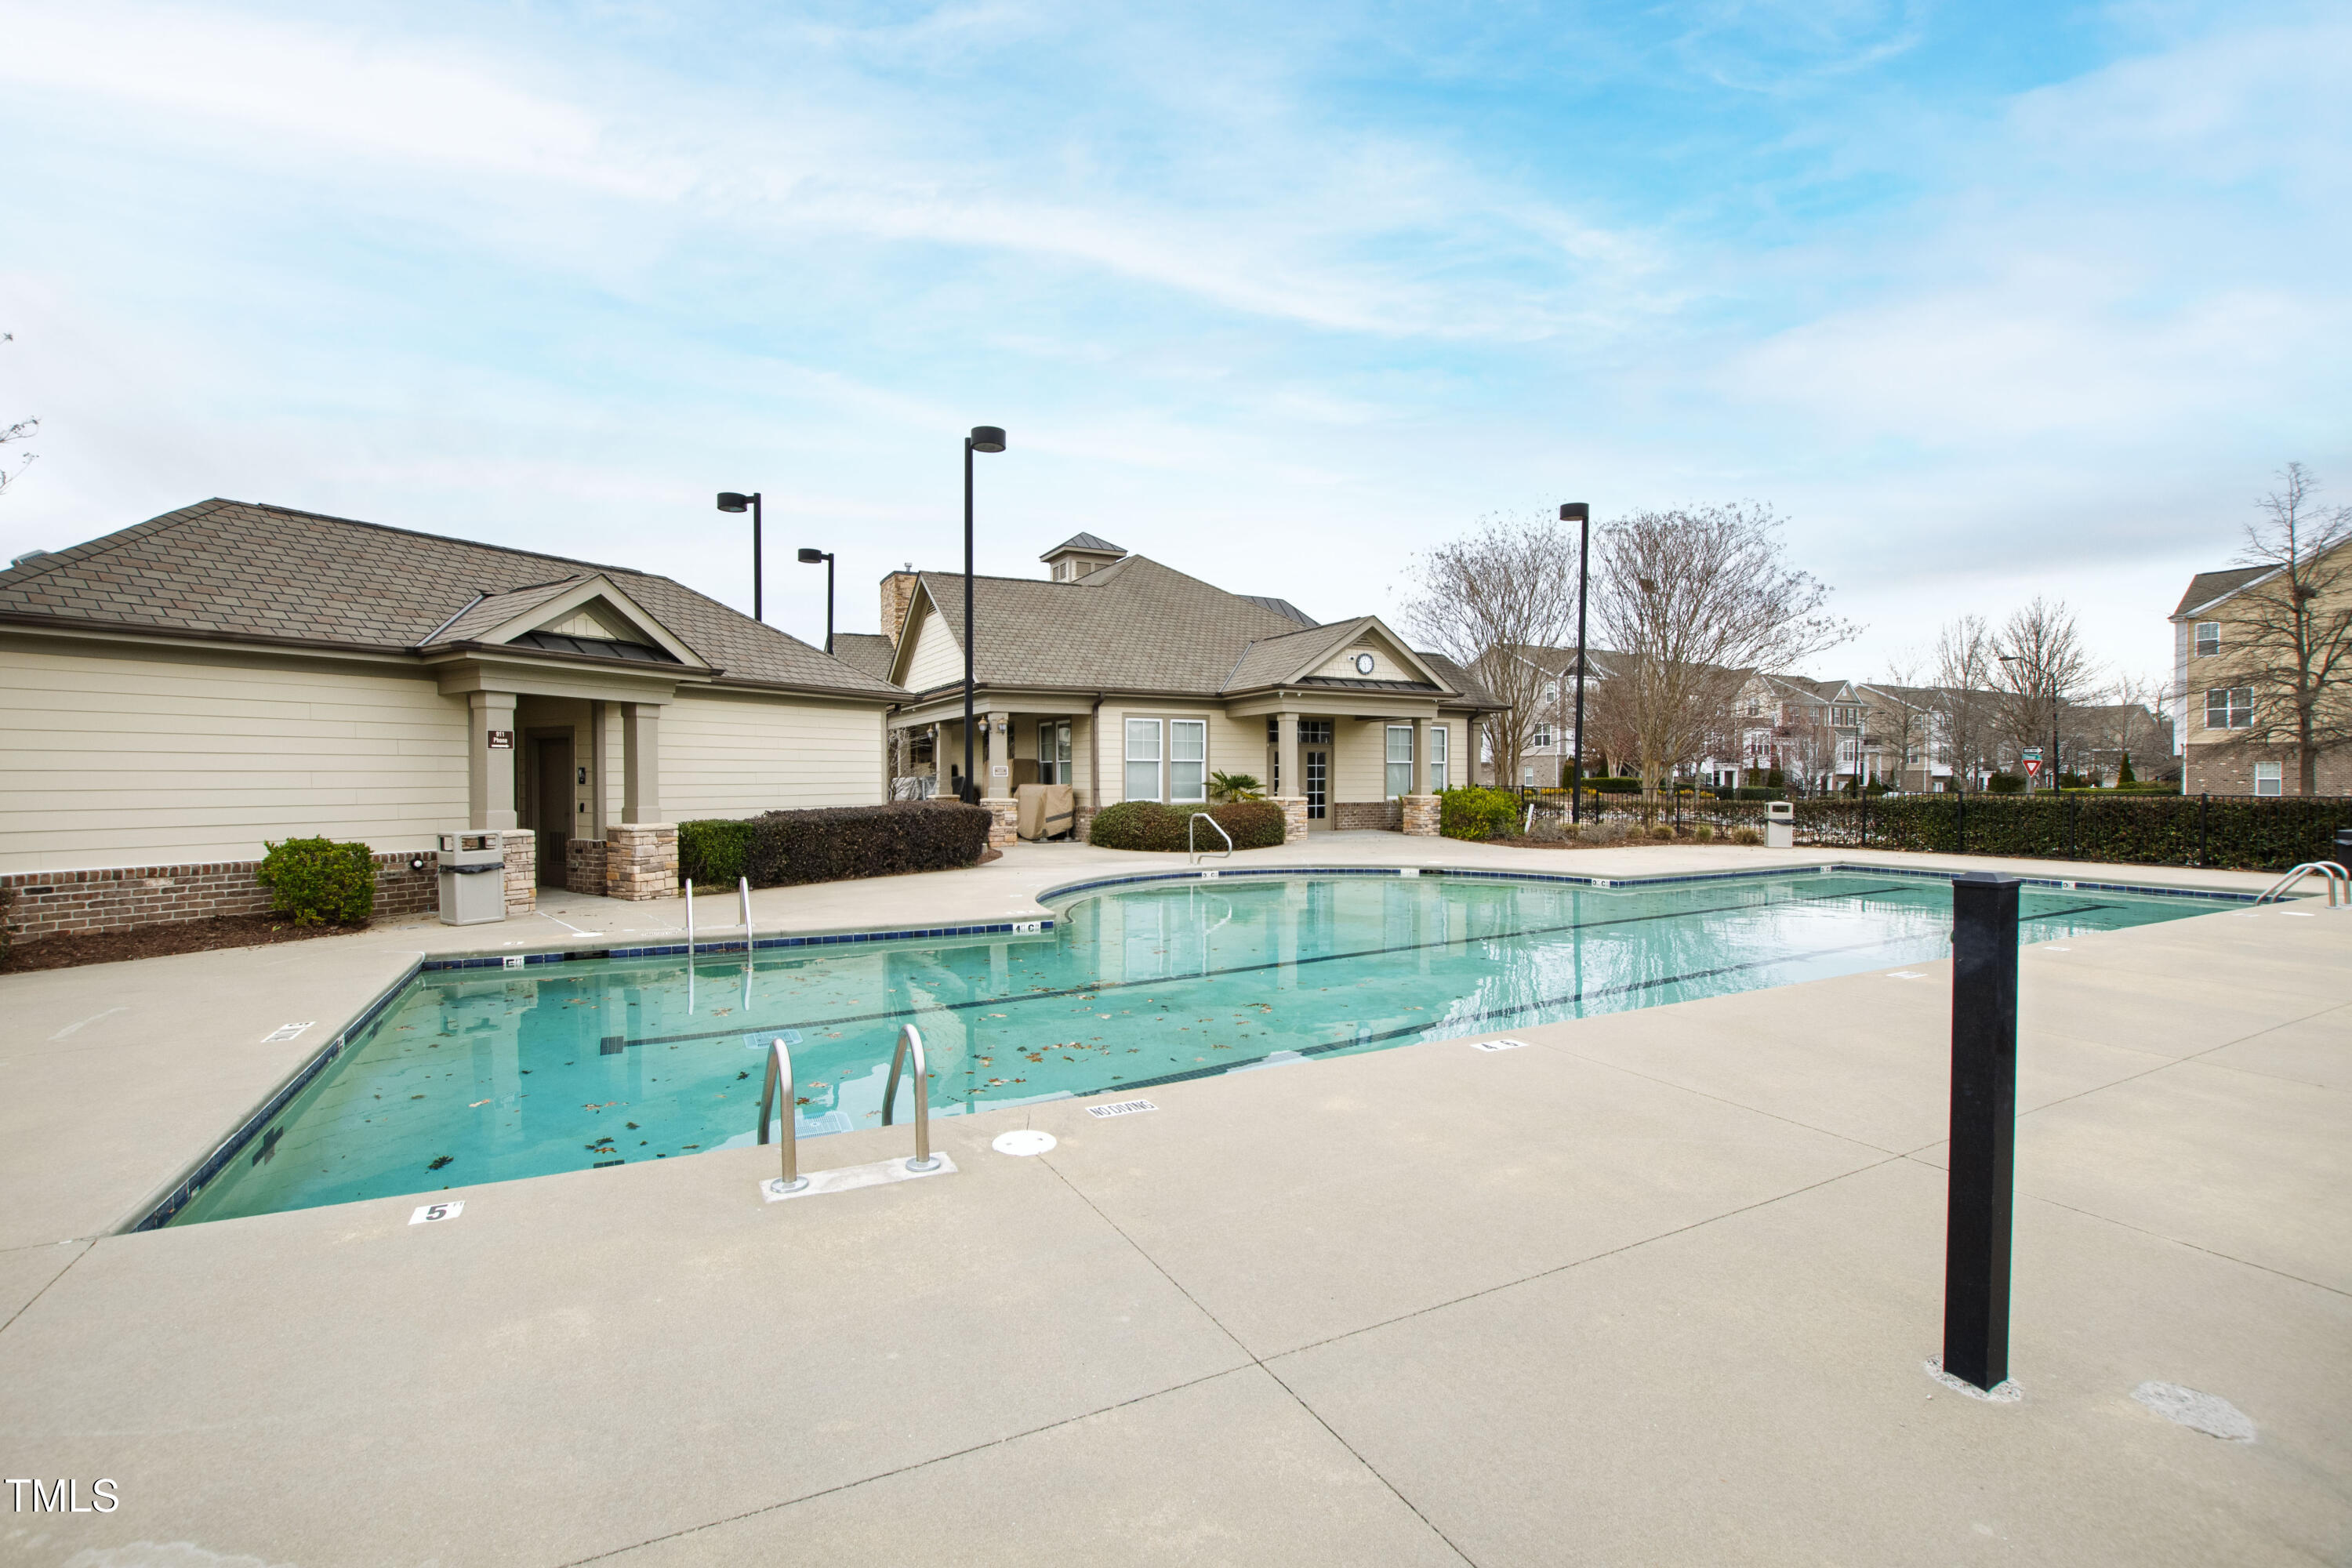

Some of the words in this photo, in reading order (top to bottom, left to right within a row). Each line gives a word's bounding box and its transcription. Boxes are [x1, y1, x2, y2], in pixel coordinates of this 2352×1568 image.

[1089, 1107, 1111, 1116] NO
[1108, 1100, 1155, 1114] DIVING
[426, 1203, 448, 1221] 5
